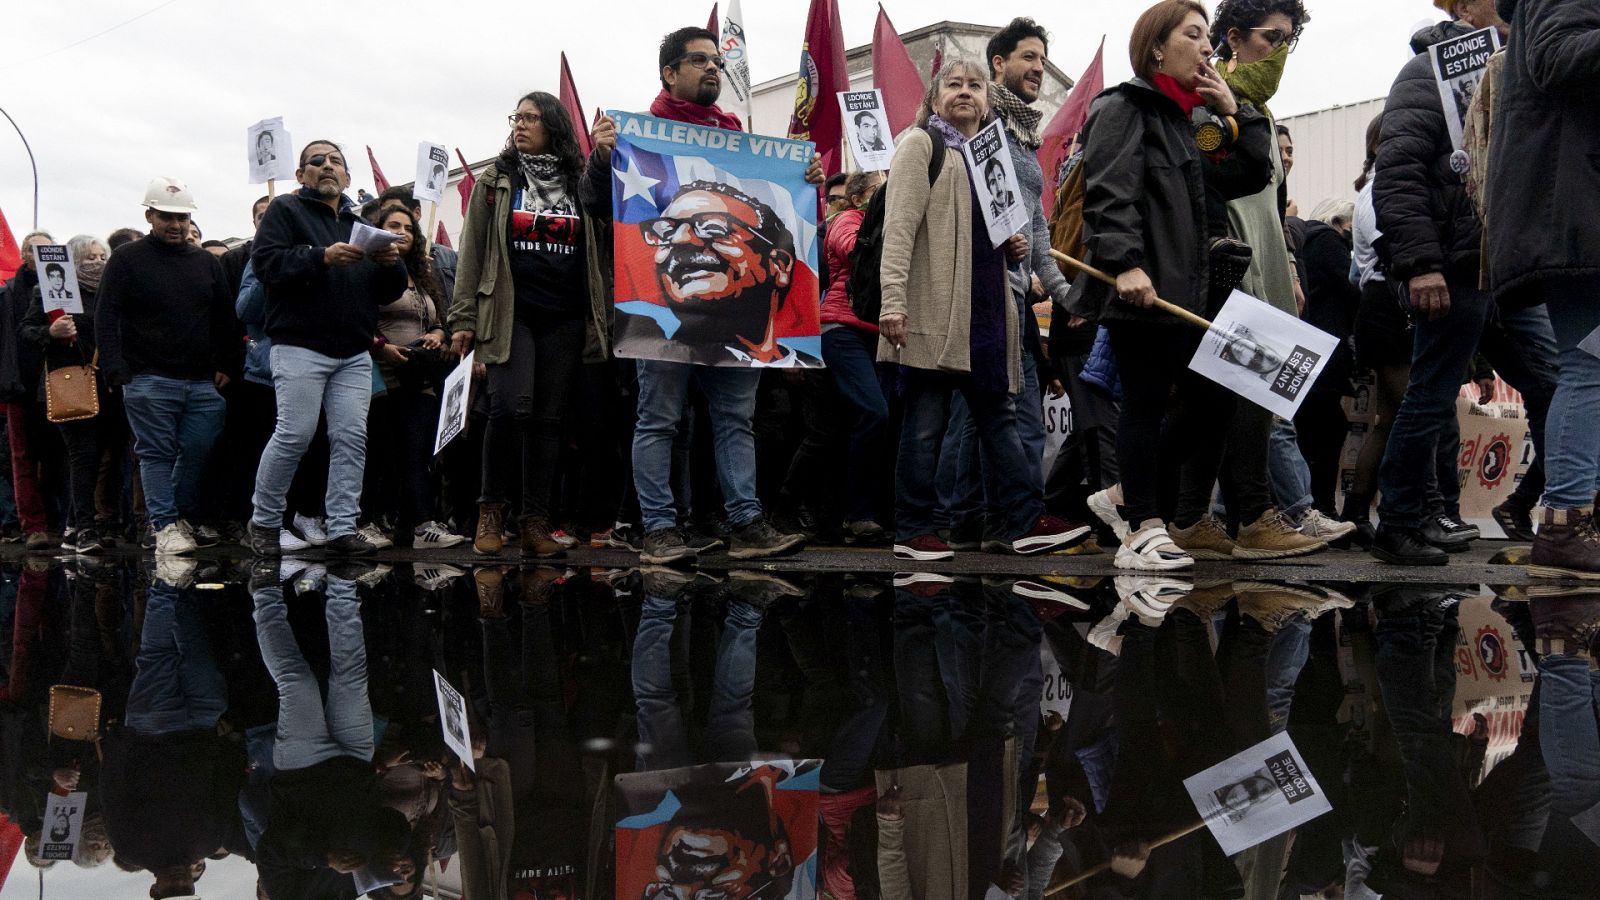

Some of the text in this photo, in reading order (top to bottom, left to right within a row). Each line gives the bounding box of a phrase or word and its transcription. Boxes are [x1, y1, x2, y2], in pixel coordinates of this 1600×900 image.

[1442, 35, 1487, 59] ¿DÓNDE
[1446, 51, 1490, 76] ESTÁN?
[847, 92, 873, 101] ¿DÓNDE
[849, 101, 875, 110] ESTÁN?
[615, 115, 812, 163] ¡ALLENDE VIVE!
[1286, 356, 1315, 395] ¿DÓNDE
